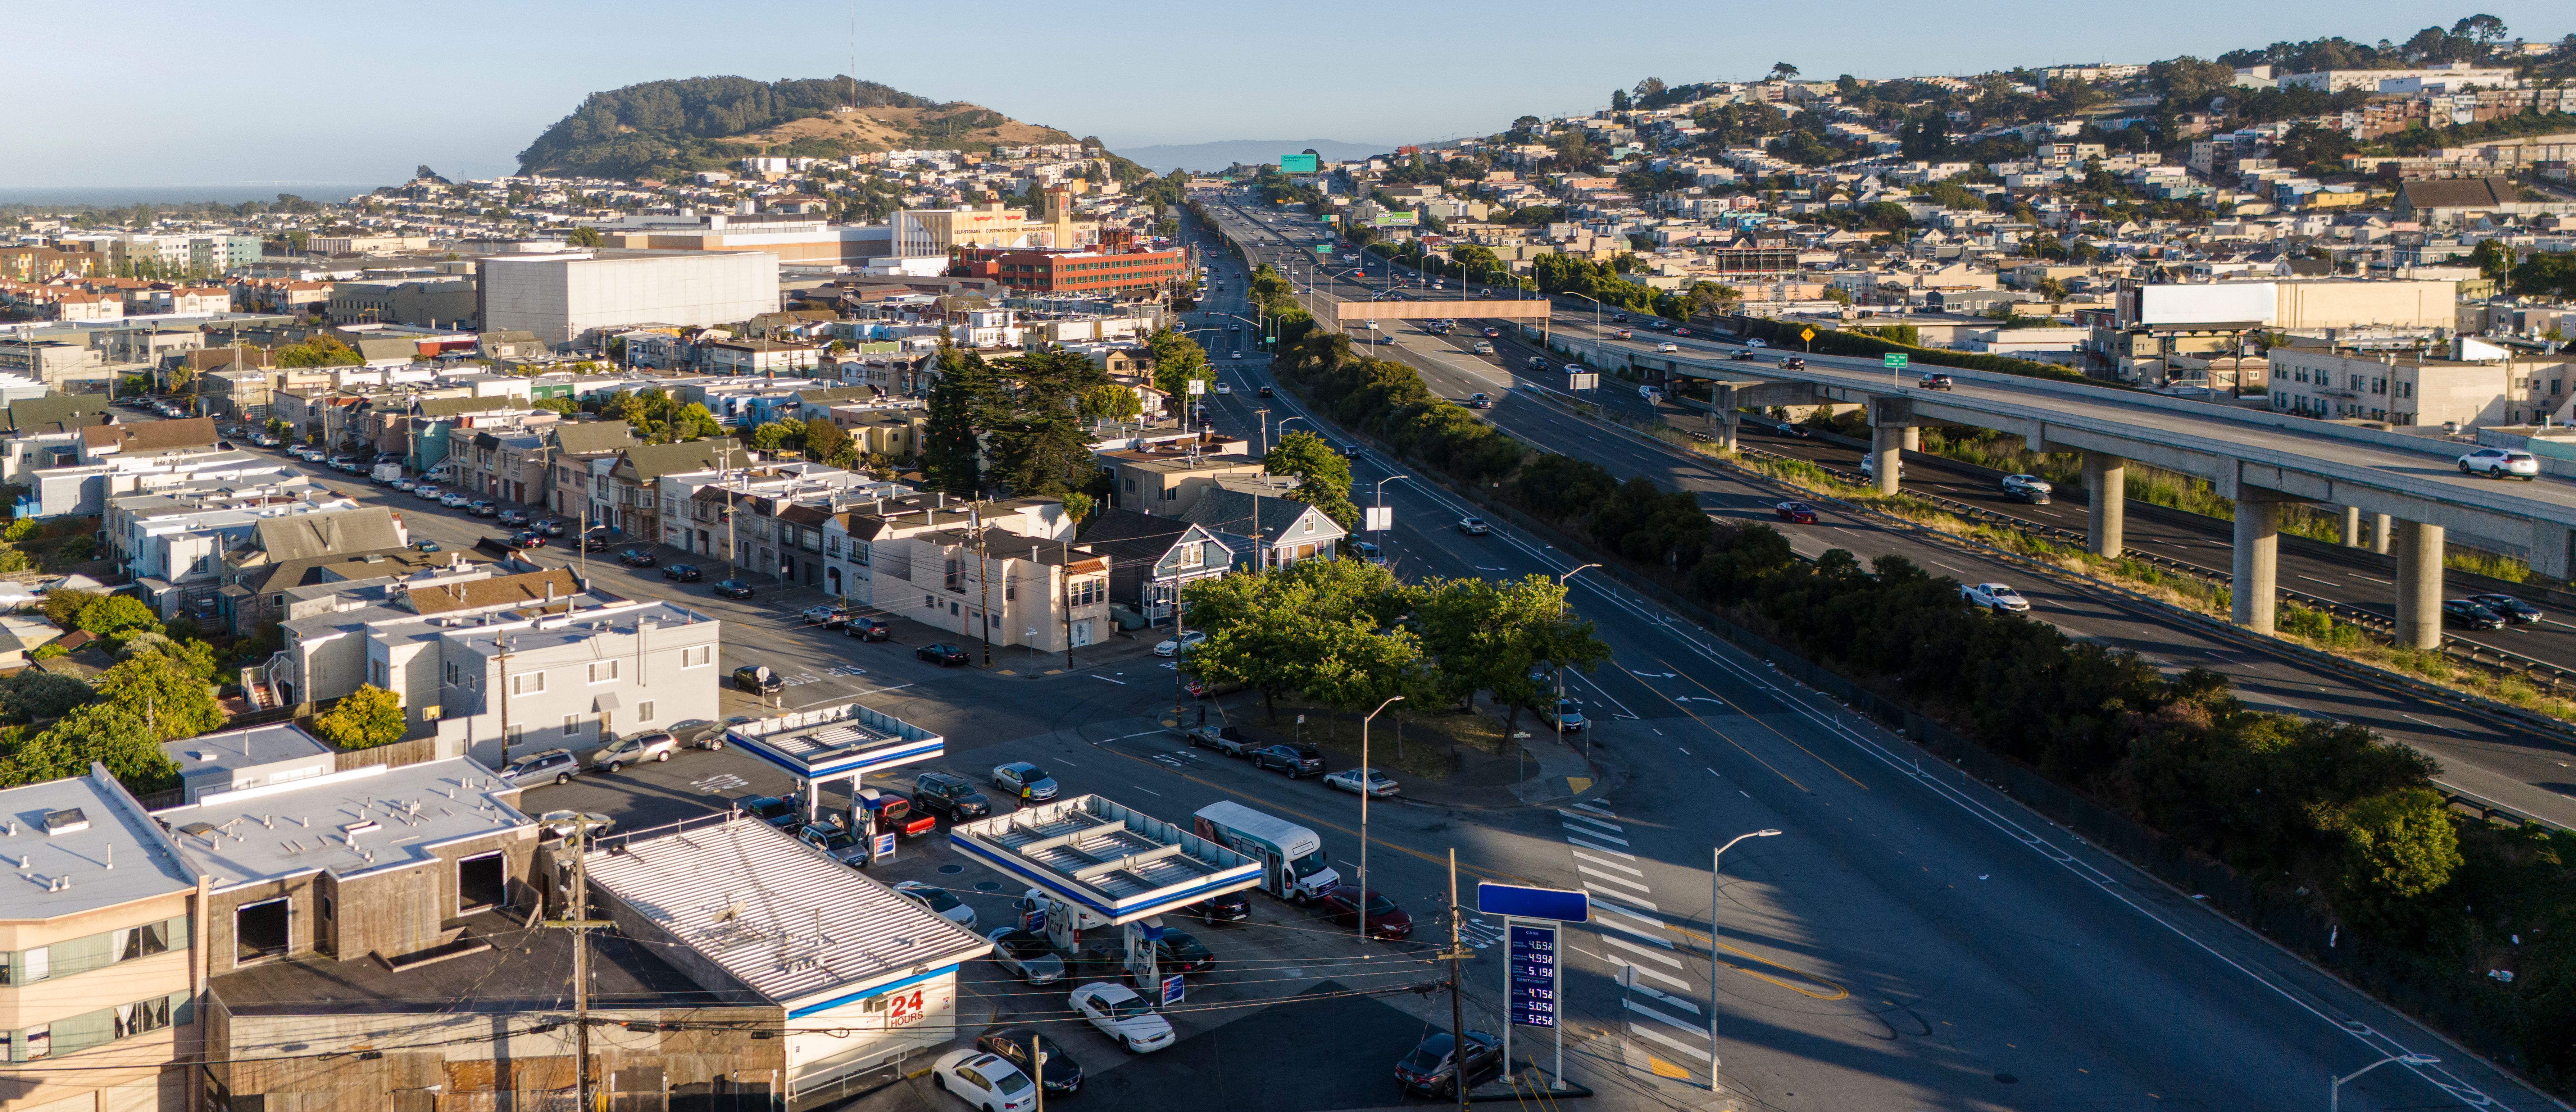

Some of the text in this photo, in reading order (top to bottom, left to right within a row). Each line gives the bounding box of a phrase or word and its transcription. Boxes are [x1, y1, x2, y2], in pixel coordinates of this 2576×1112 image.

[825, 665, 867, 677] STOP
[780, 673, 821, 686] STOP
[892, 990, 923, 1018] 24
[891, 1011, 923, 1028] HOURS
